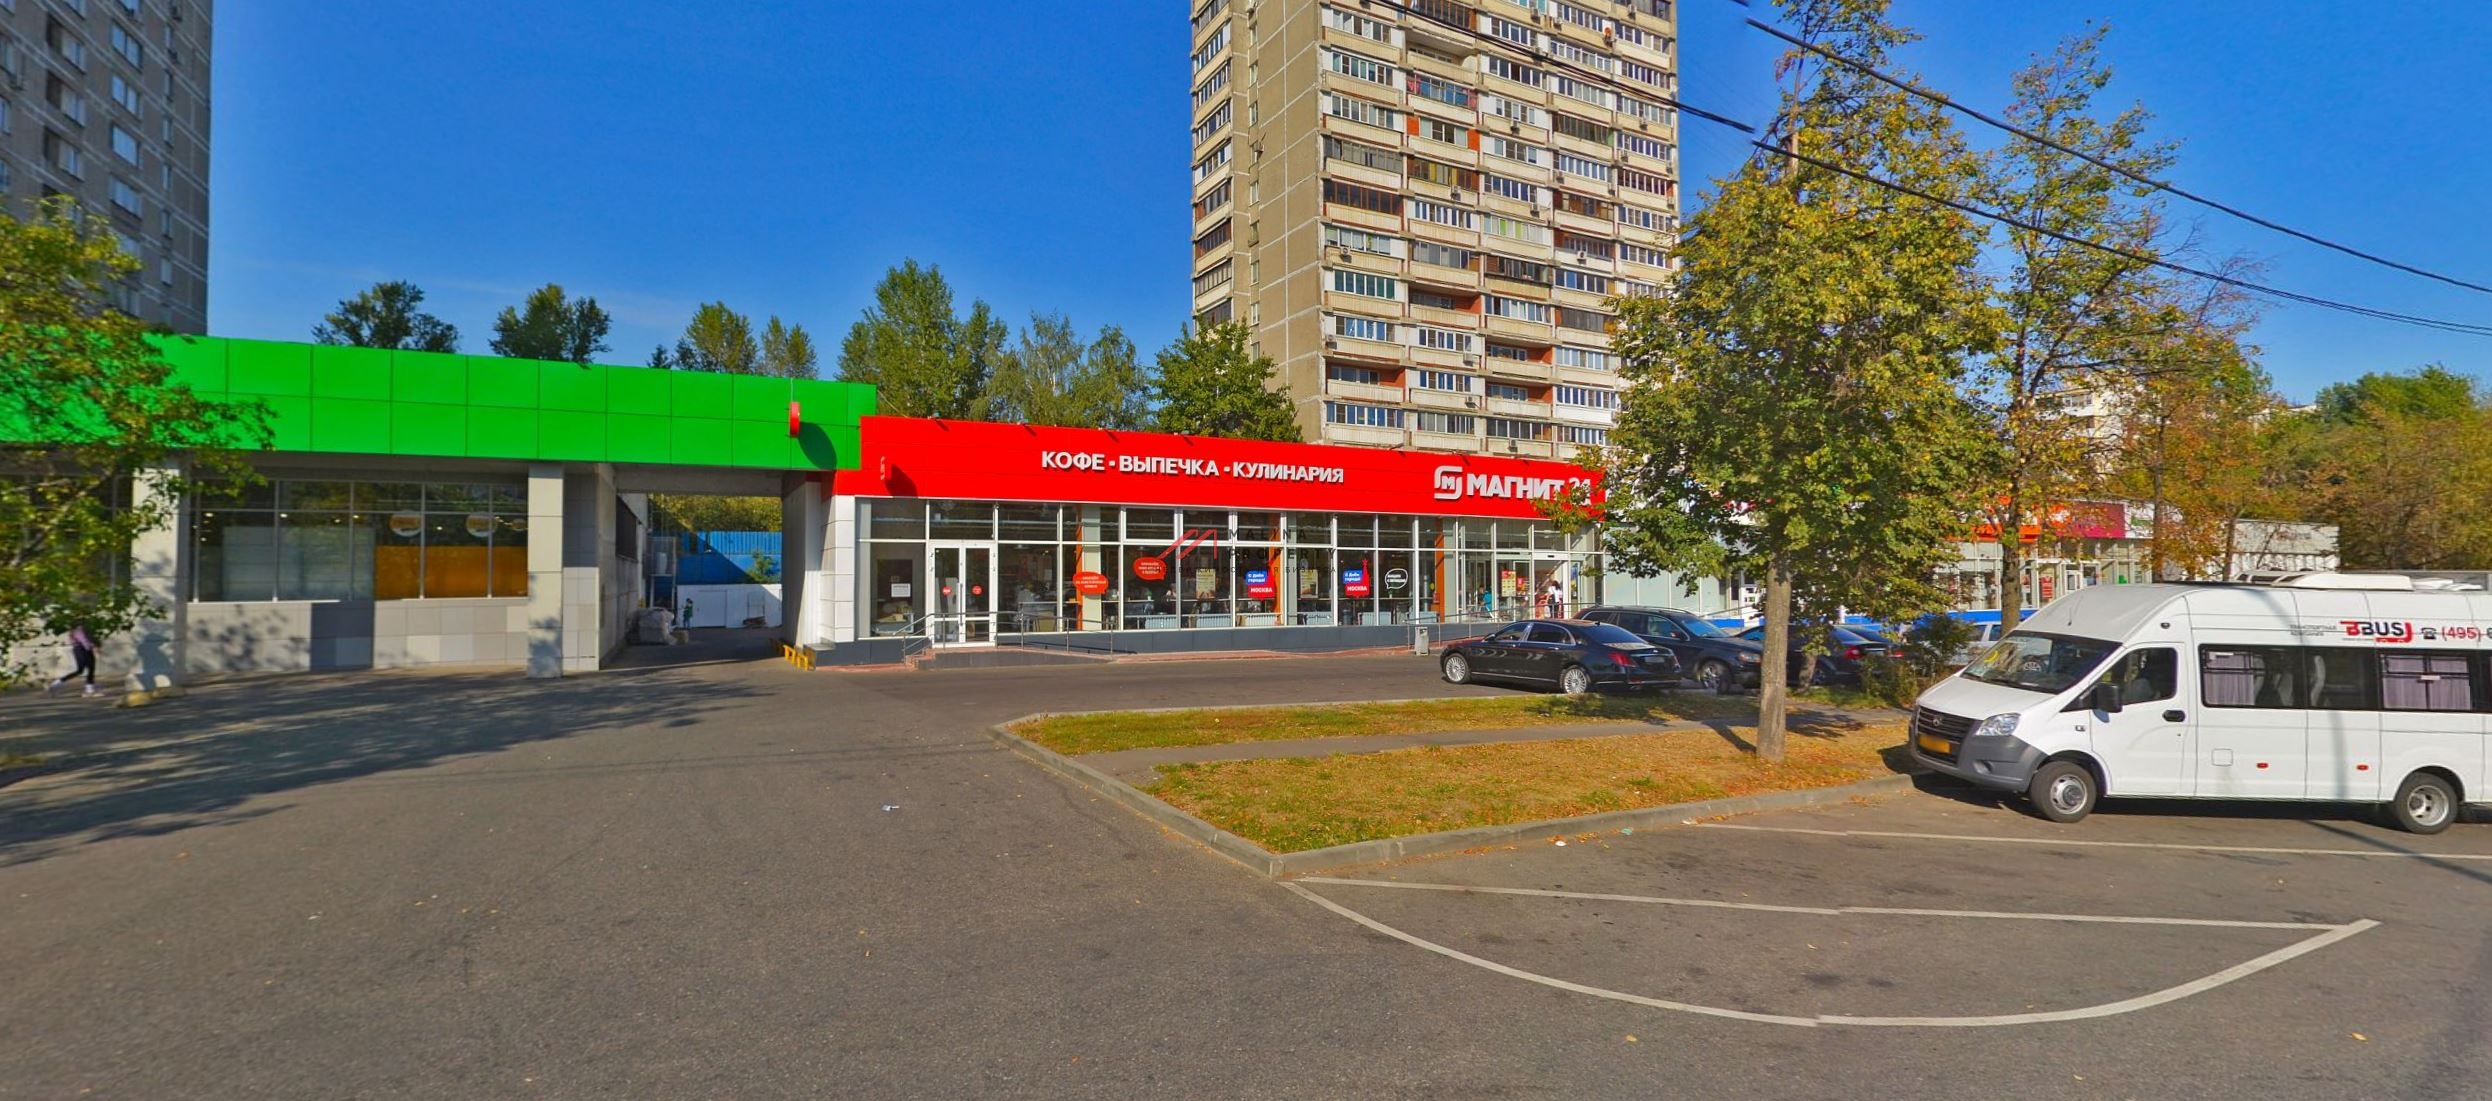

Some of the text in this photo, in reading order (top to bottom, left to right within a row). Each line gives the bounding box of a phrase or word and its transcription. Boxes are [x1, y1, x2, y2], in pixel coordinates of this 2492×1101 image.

[1041, 450, 1344, 483] КОФЕ ВЫПЕЧКА КУЛИНАРИЯ
[1466, 473, 1565, 502] МАГНИТ
[2441, 627, 2481, 642] (495)
